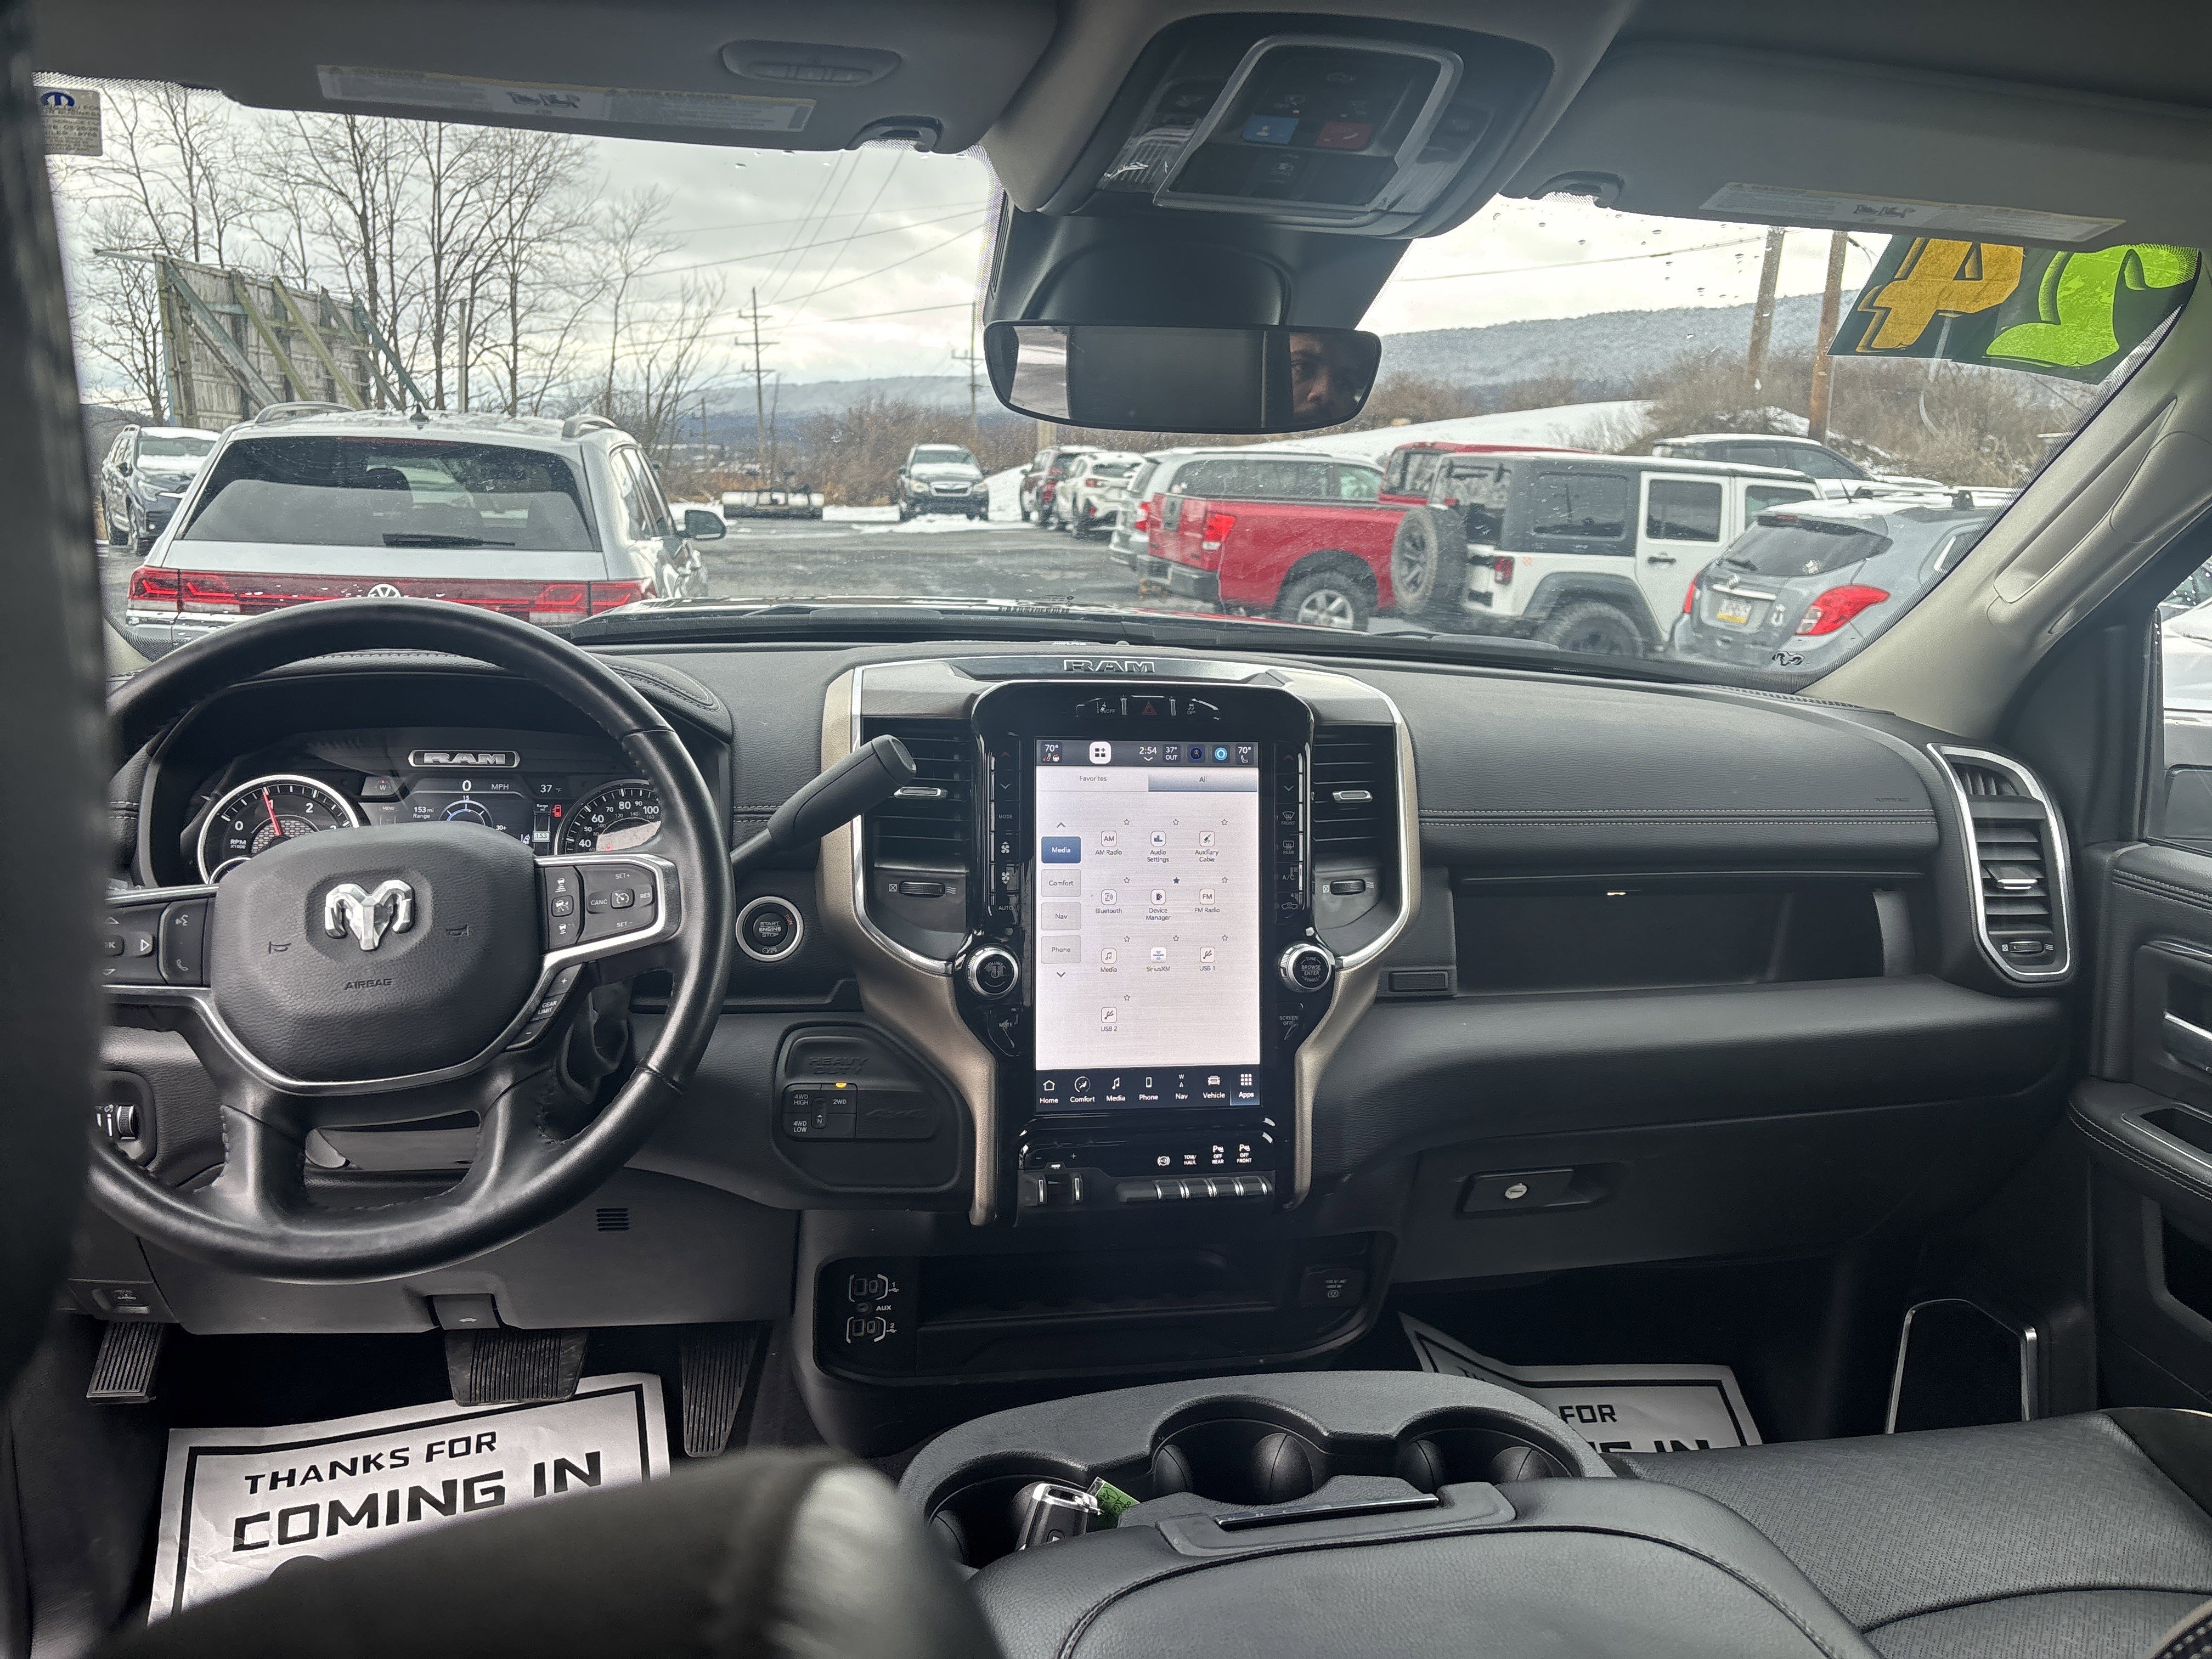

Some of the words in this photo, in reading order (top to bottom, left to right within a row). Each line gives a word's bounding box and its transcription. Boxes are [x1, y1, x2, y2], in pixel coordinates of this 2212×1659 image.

[1064, 659, 1155, 673] RAM
[1138, 746, 1157, 755] 2:54
[424, 753, 505, 765] RAM
[462, 780, 471, 792] 0
[540, 784, 552, 793] 37
[306, 803, 313, 813] 2
[618, 801, 631, 810] 80
[642, 805, 659, 815] 100
[591, 814, 605, 823] 60
[235, 821, 244, 831] 0
[578, 839, 591, 848] 40
[784, 914, 794, 926] RUN
[343, 978, 393, 990] AIRBAG
[542, 1000, 557, 1008] GEAR
[808, 1056, 870, 1065] HEAVY
[814, 1065, 863, 1075] DUTY
[1238, 1091, 1255, 1099] Apps
[1559, 1404, 1618, 1424] FOR
[244, 1447, 410, 1495] THANKS
[425, 1431, 498, 1463] FOR
[232, 1470, 506, 1553] COMING
[533, 1451, 602, 1499] IN
